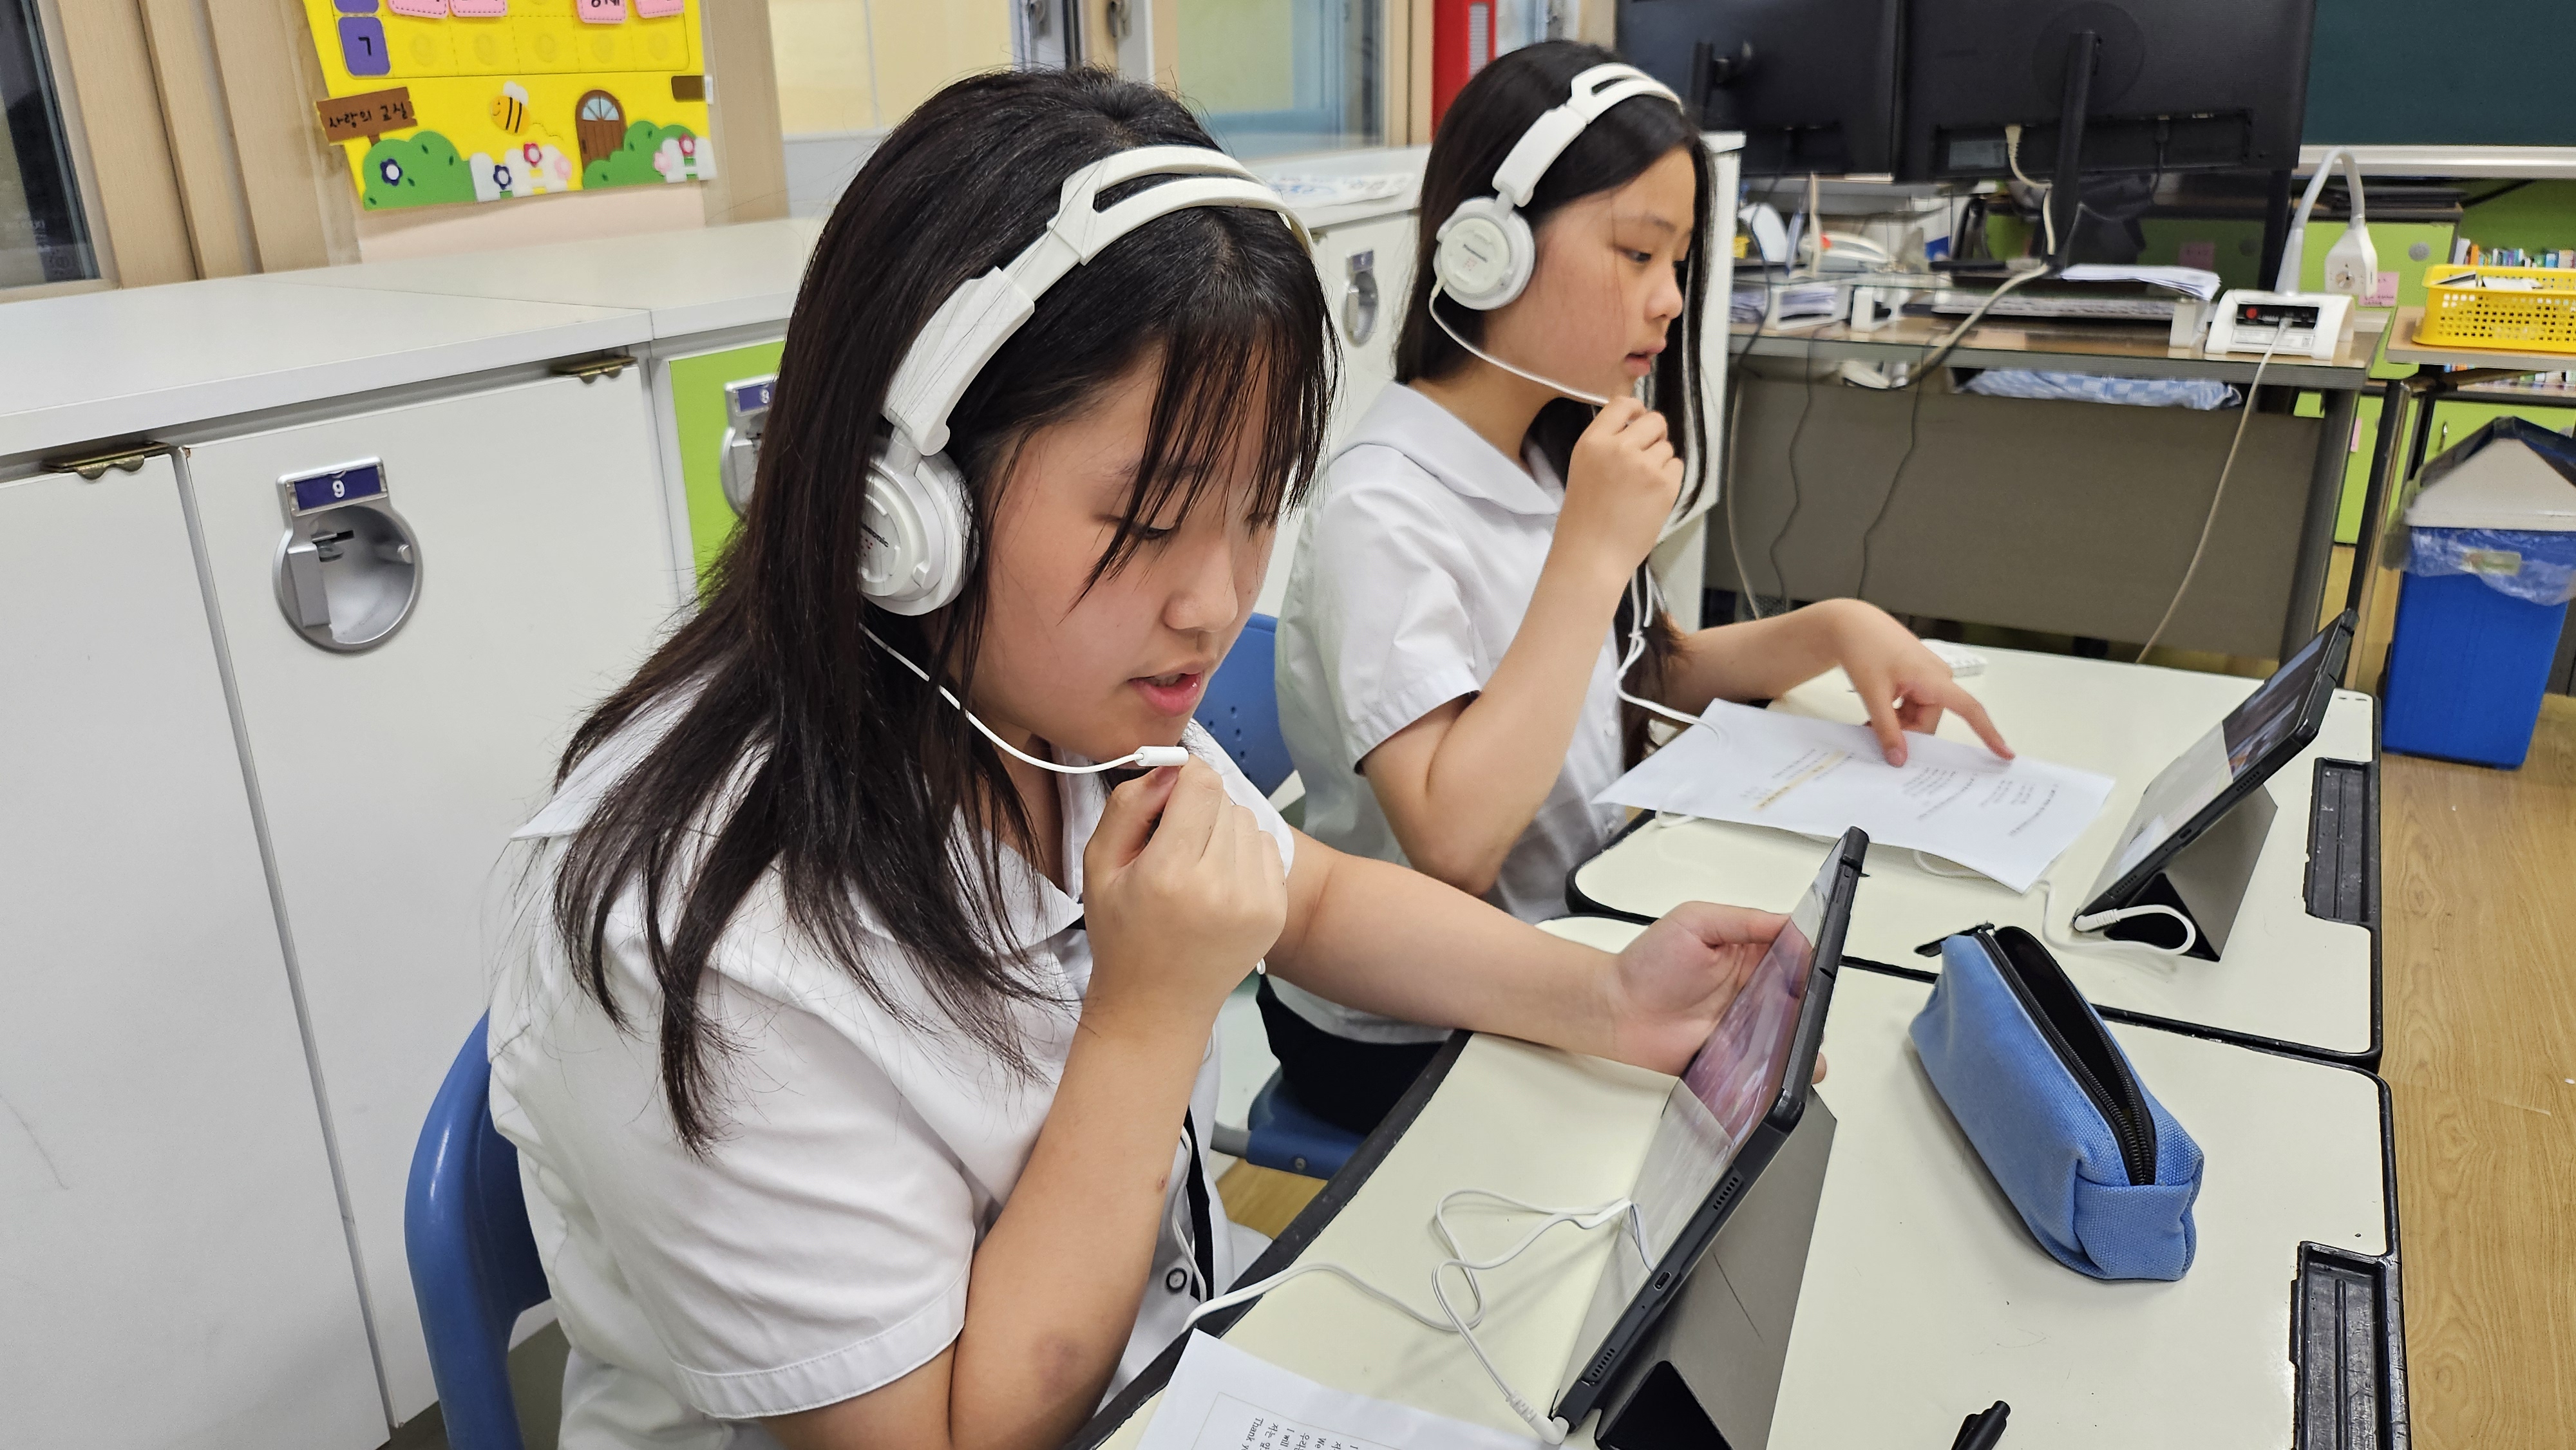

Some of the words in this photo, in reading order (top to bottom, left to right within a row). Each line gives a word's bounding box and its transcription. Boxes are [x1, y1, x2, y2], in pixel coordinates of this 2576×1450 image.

[329, 109, 372, 128] 사랑의
[380, 101, 408, 122] 교실
[333, 480, 345, 498] 9
[1245, 1417, 1264, 1442] Thank
[1264, 1422, 1278, 1438] 저는
[1280, 1435, 1291, 1447] will
[1314, 1437, 1327, 1449] We
